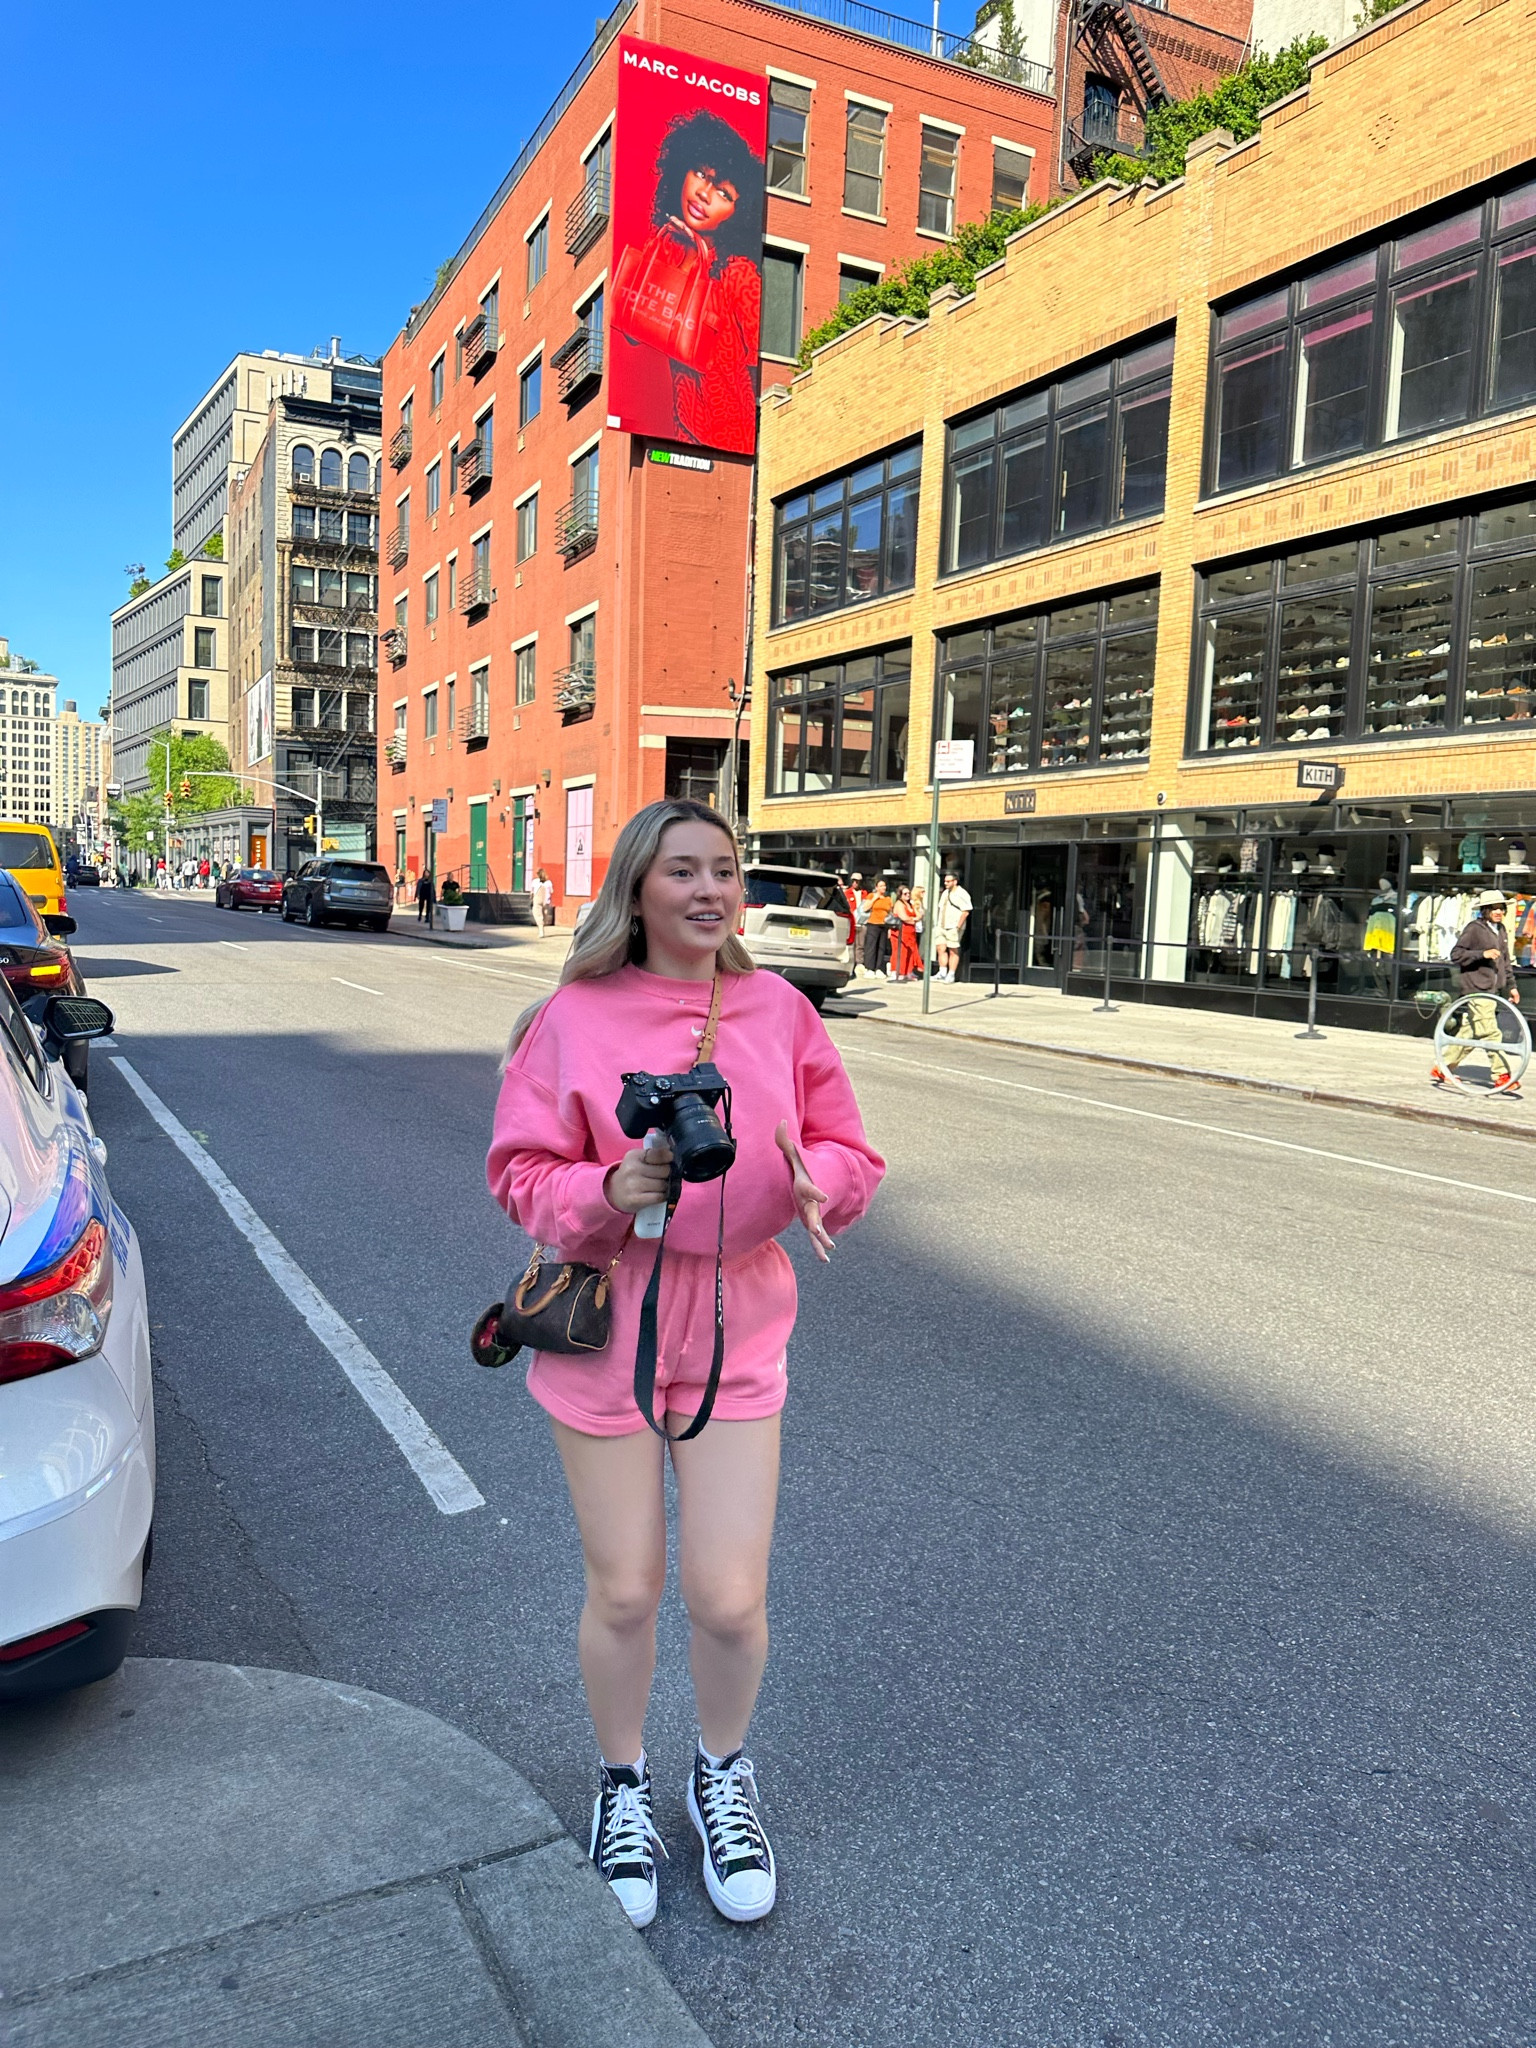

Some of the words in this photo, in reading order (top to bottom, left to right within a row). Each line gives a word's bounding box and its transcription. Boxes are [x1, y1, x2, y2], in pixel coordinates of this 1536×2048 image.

[623, 50, 679, 80] MARC
[684, 72, 761, 106] JACOBS
[621, 286, 659, 312] TOTE
[661, 305, 696, 330] BAG
[647, 281, 677, 305] THE
[1304, 768, 1333, 782] KITH
